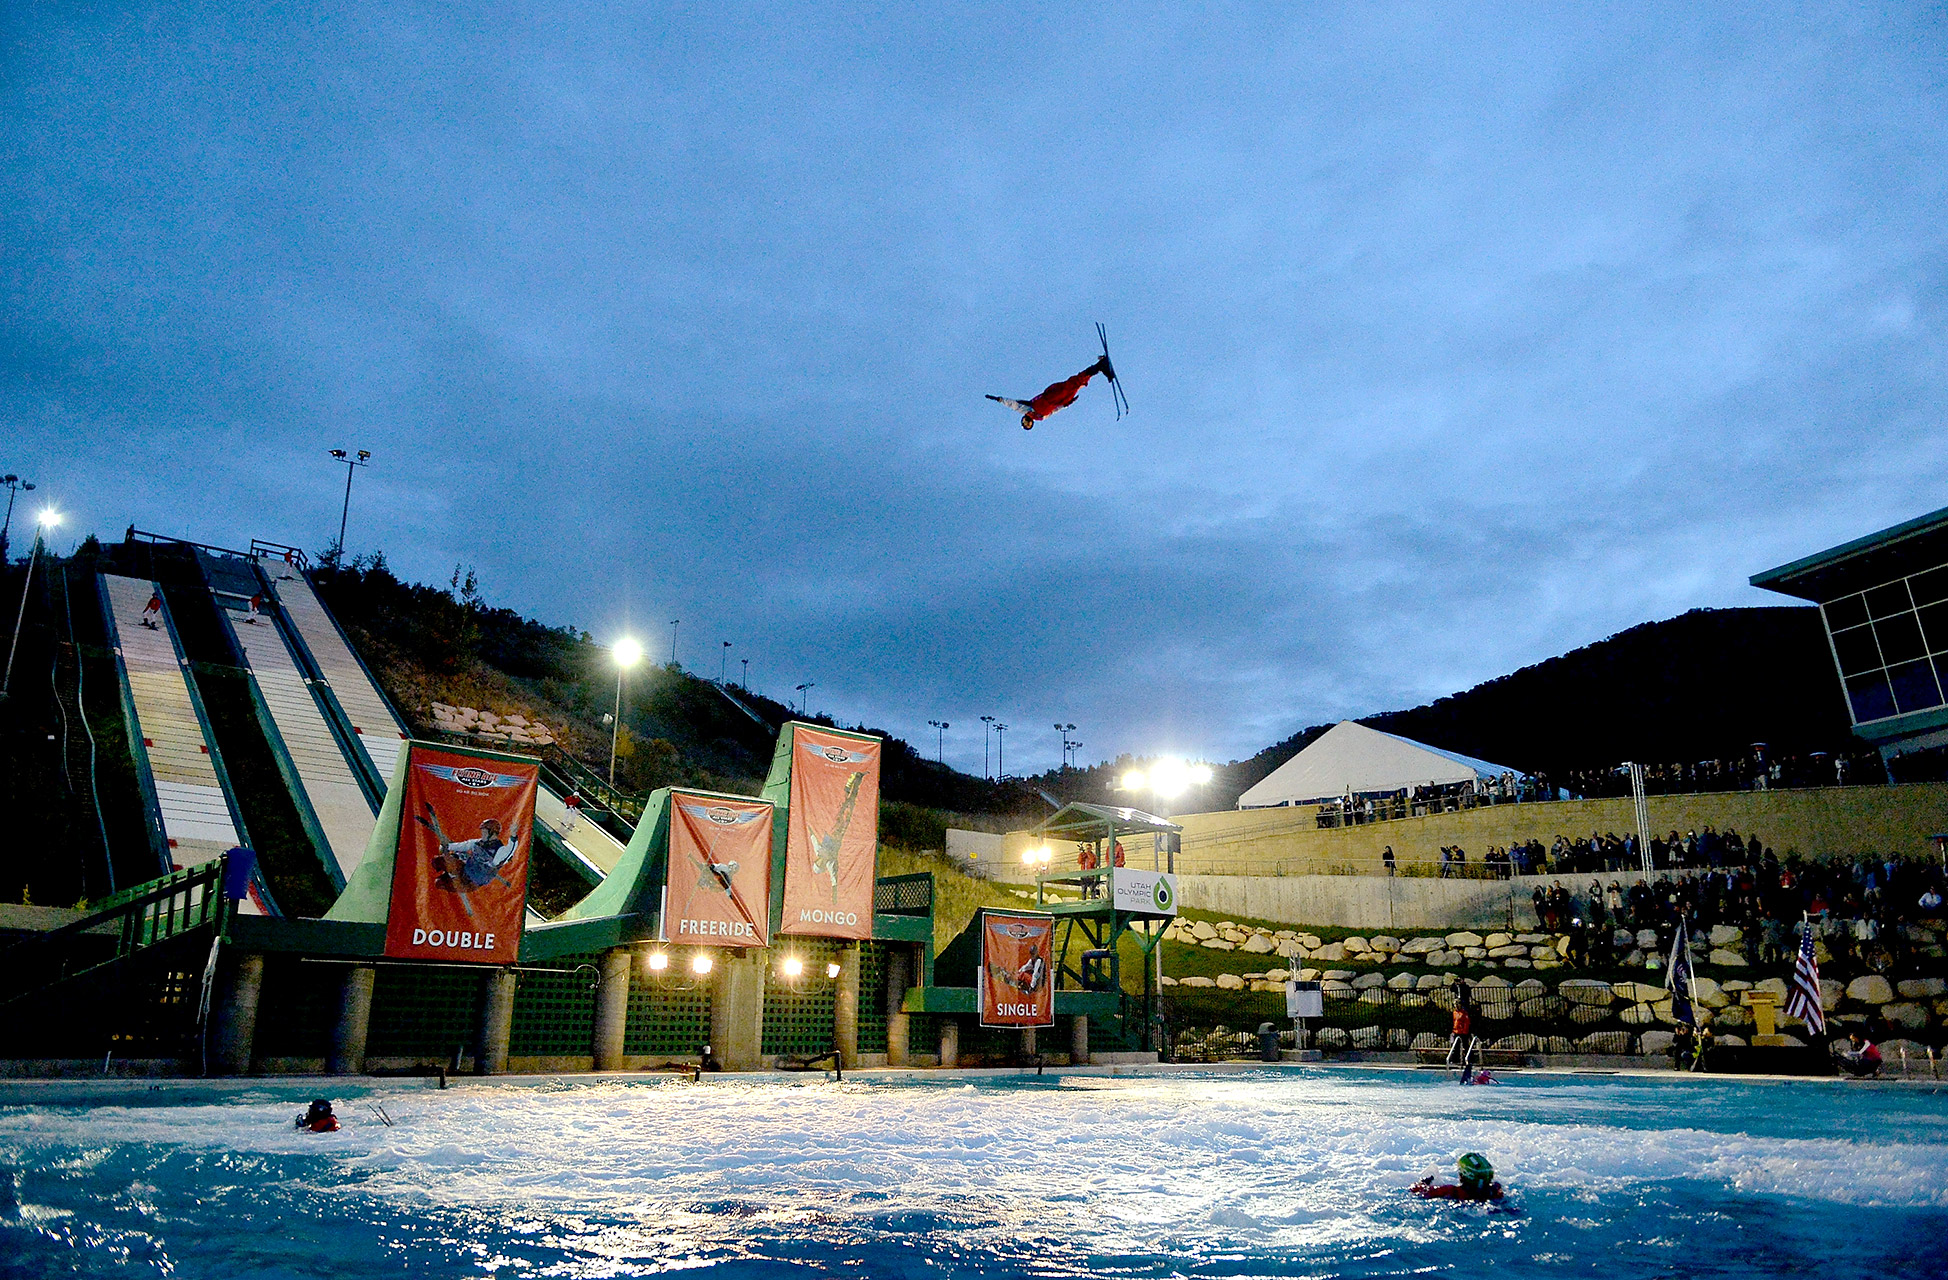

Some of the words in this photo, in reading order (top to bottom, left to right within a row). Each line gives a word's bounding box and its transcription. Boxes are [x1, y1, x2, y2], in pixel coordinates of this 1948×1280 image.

[1117, 887, 1152, 898] OLYMPIC
[1130, 881, 1152, 890] UTAH
[1130, 897, 1151, 905] PARK
[799, 908, 858, 926] MONGO
[679, 919, 755, 937] FREERIDE
[412, 928, 495, 950] DOUBLE
[996, 1003, 1037, 1017] SINGLE
